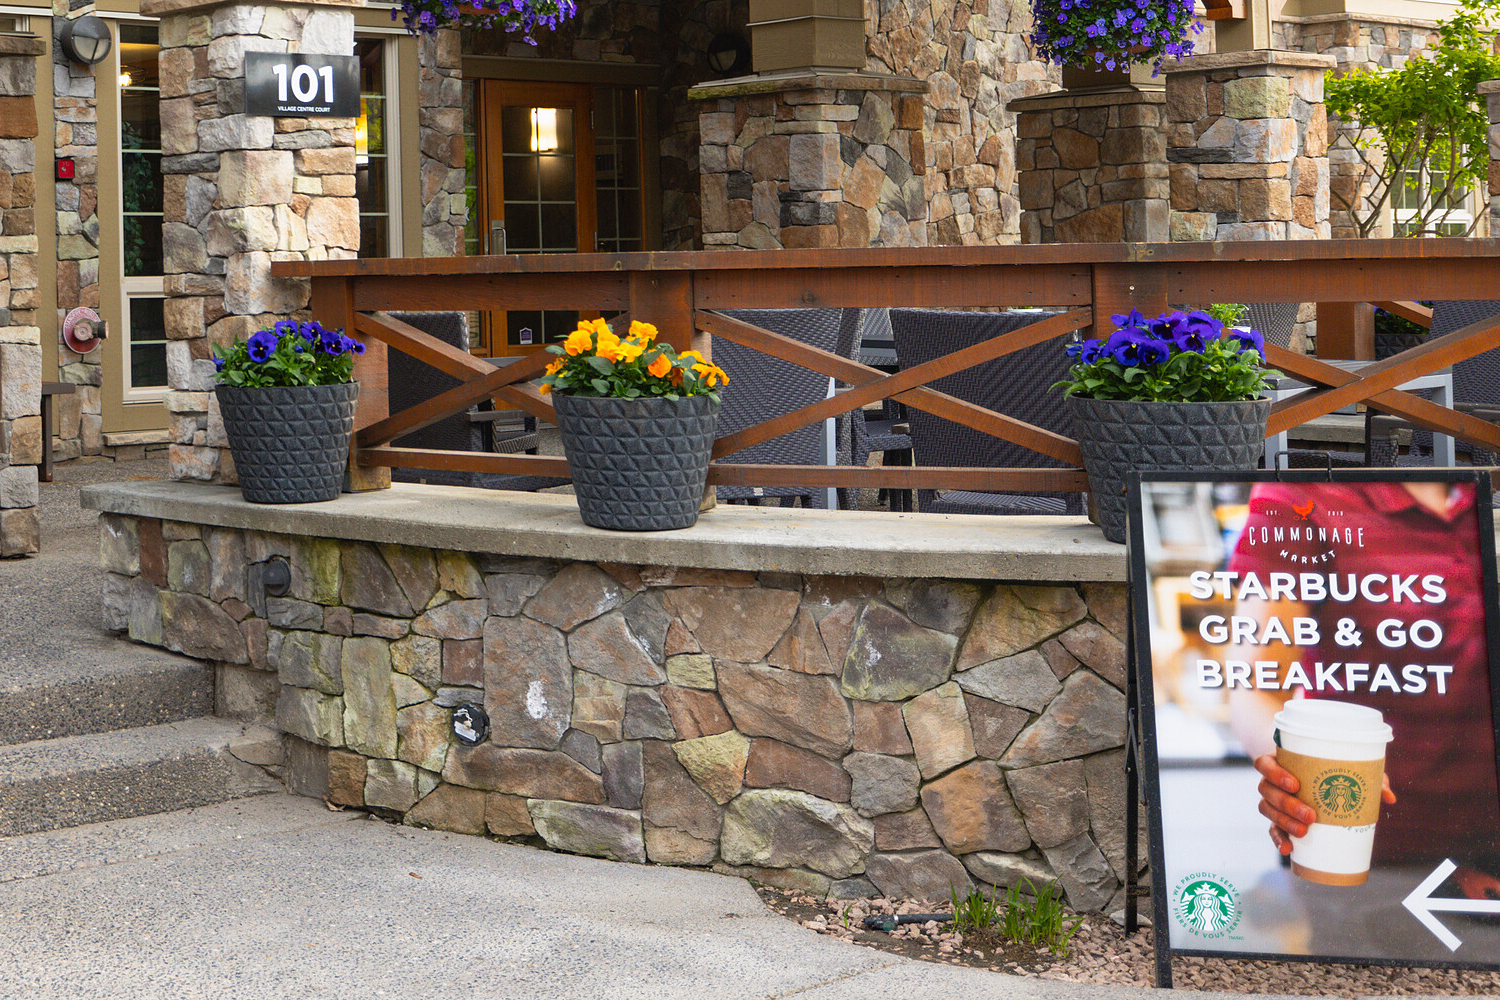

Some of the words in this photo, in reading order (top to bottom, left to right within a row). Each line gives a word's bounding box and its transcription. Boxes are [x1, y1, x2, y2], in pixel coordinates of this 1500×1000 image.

[272, 63, 334, 103] 101
[1249, 526, 1365, 547] COMMONAGE
[1280, 549, 1336, 564] MARKET
[1189, 571, 1447, 603] STARBUCKS
[1199, 615, 1321, 646] GRAB
[1334, 617, 1363, 647] &
[1376, 618, 1443, 649] GO
[1196, 659, 1453, 694] BREAKFAST
[1320, 768, 1351, 777] PROUDLY
[1172, 884, 1182, 896] WE
[1180, 871, 1217, 884] PROUDLY
[1219, 877, 1240, 897] SERVE
[1172, 907, 1188, 928] FIERS
[1188, 927, 1199, 936] DE
[1202, 931, 1225, 939] VOUS
[1226, 910, 1243, 934] SERVIR
